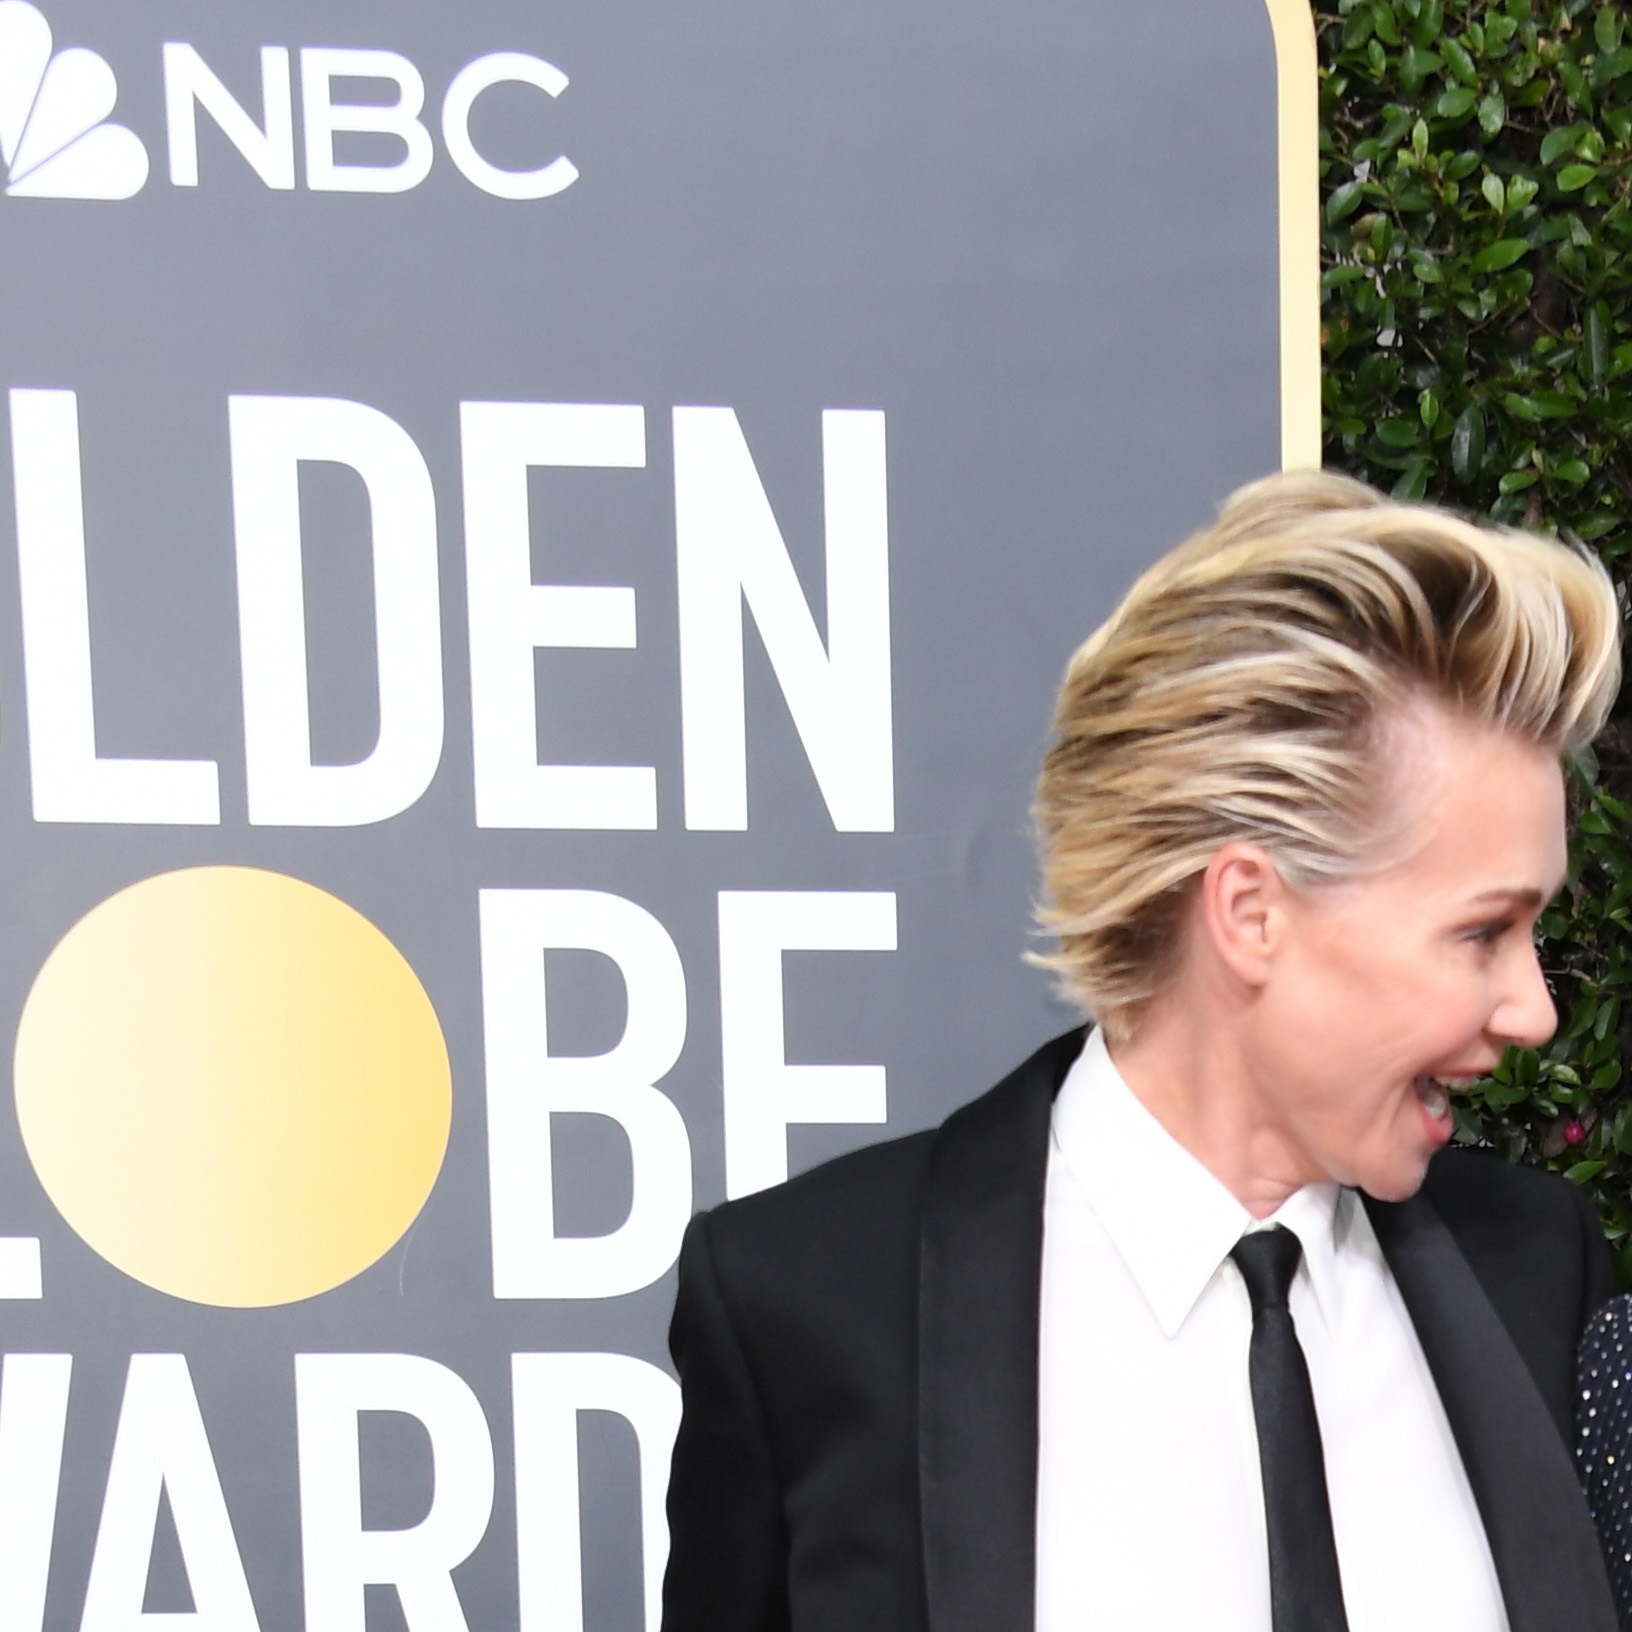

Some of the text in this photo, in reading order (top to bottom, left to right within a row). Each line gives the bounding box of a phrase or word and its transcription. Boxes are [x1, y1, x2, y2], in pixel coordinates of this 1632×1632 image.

[162, 42, 580, 200] NBC
[8, 387, 895, 833] LDEN
[0, 865, 898, 1308] OBE
